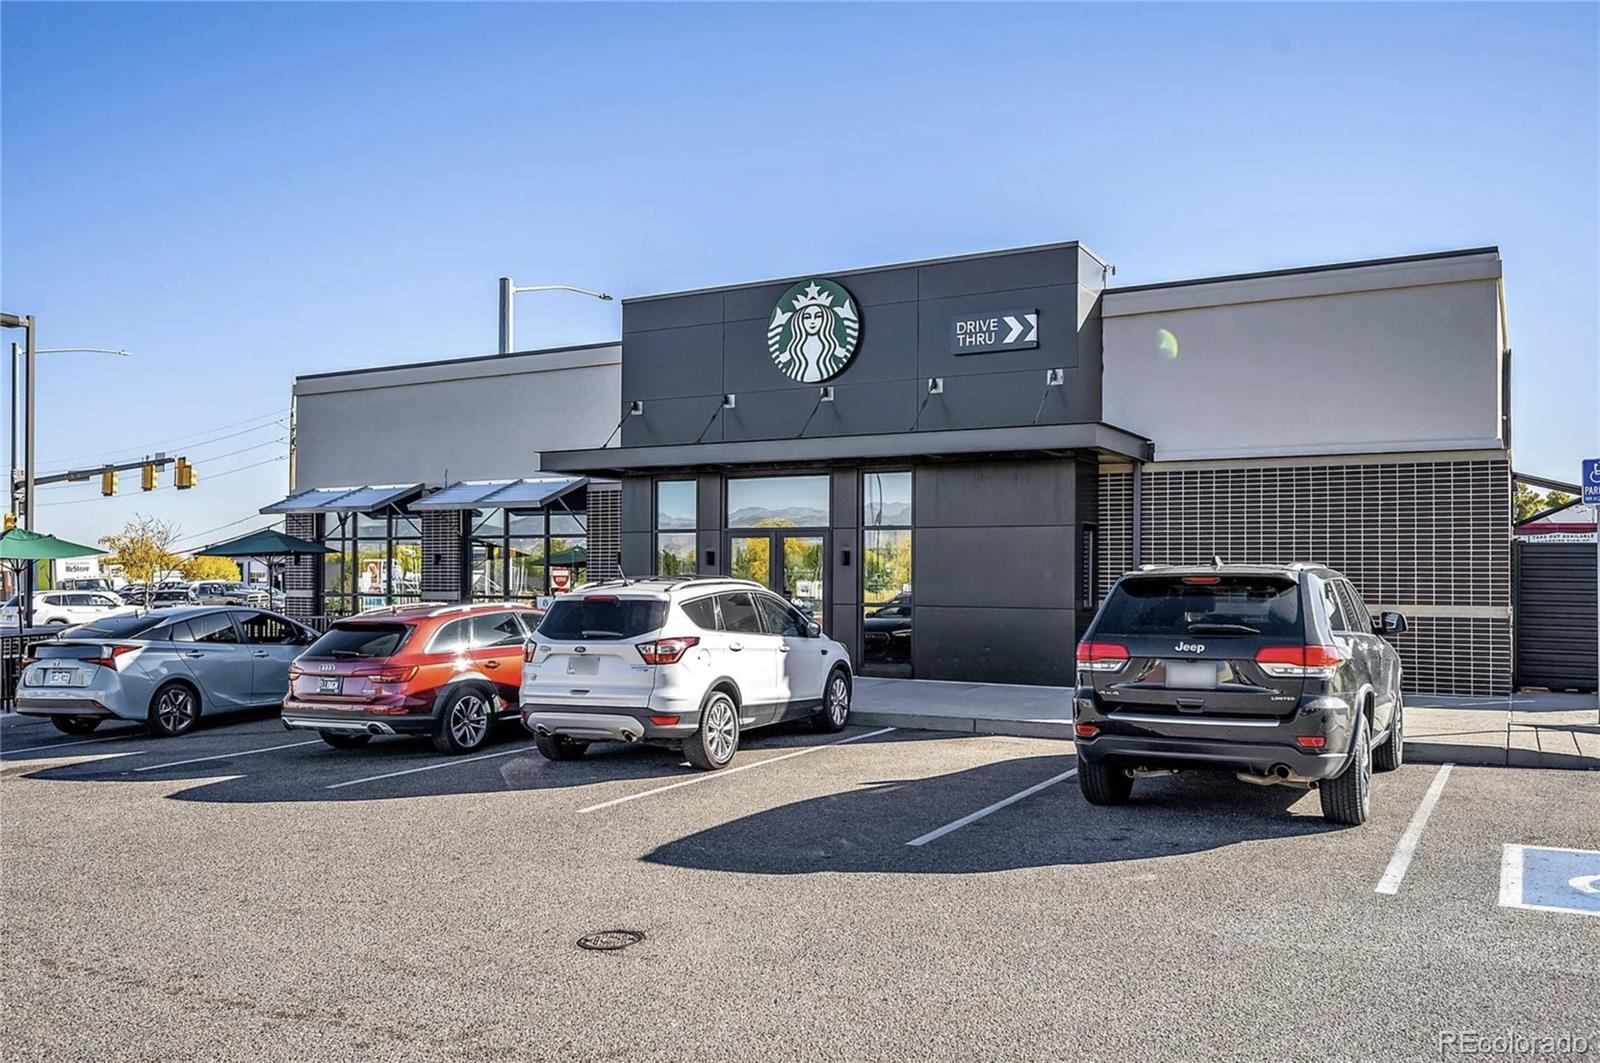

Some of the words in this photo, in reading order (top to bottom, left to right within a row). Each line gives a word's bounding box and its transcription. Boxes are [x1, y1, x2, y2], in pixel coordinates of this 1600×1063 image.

[956, 318, 998, 334] DRIVE
[957, 332, 996, 347] THRU
[1584, 486, 1600, 495] PAR
[1175, 641, 1205, 653] Jeep
